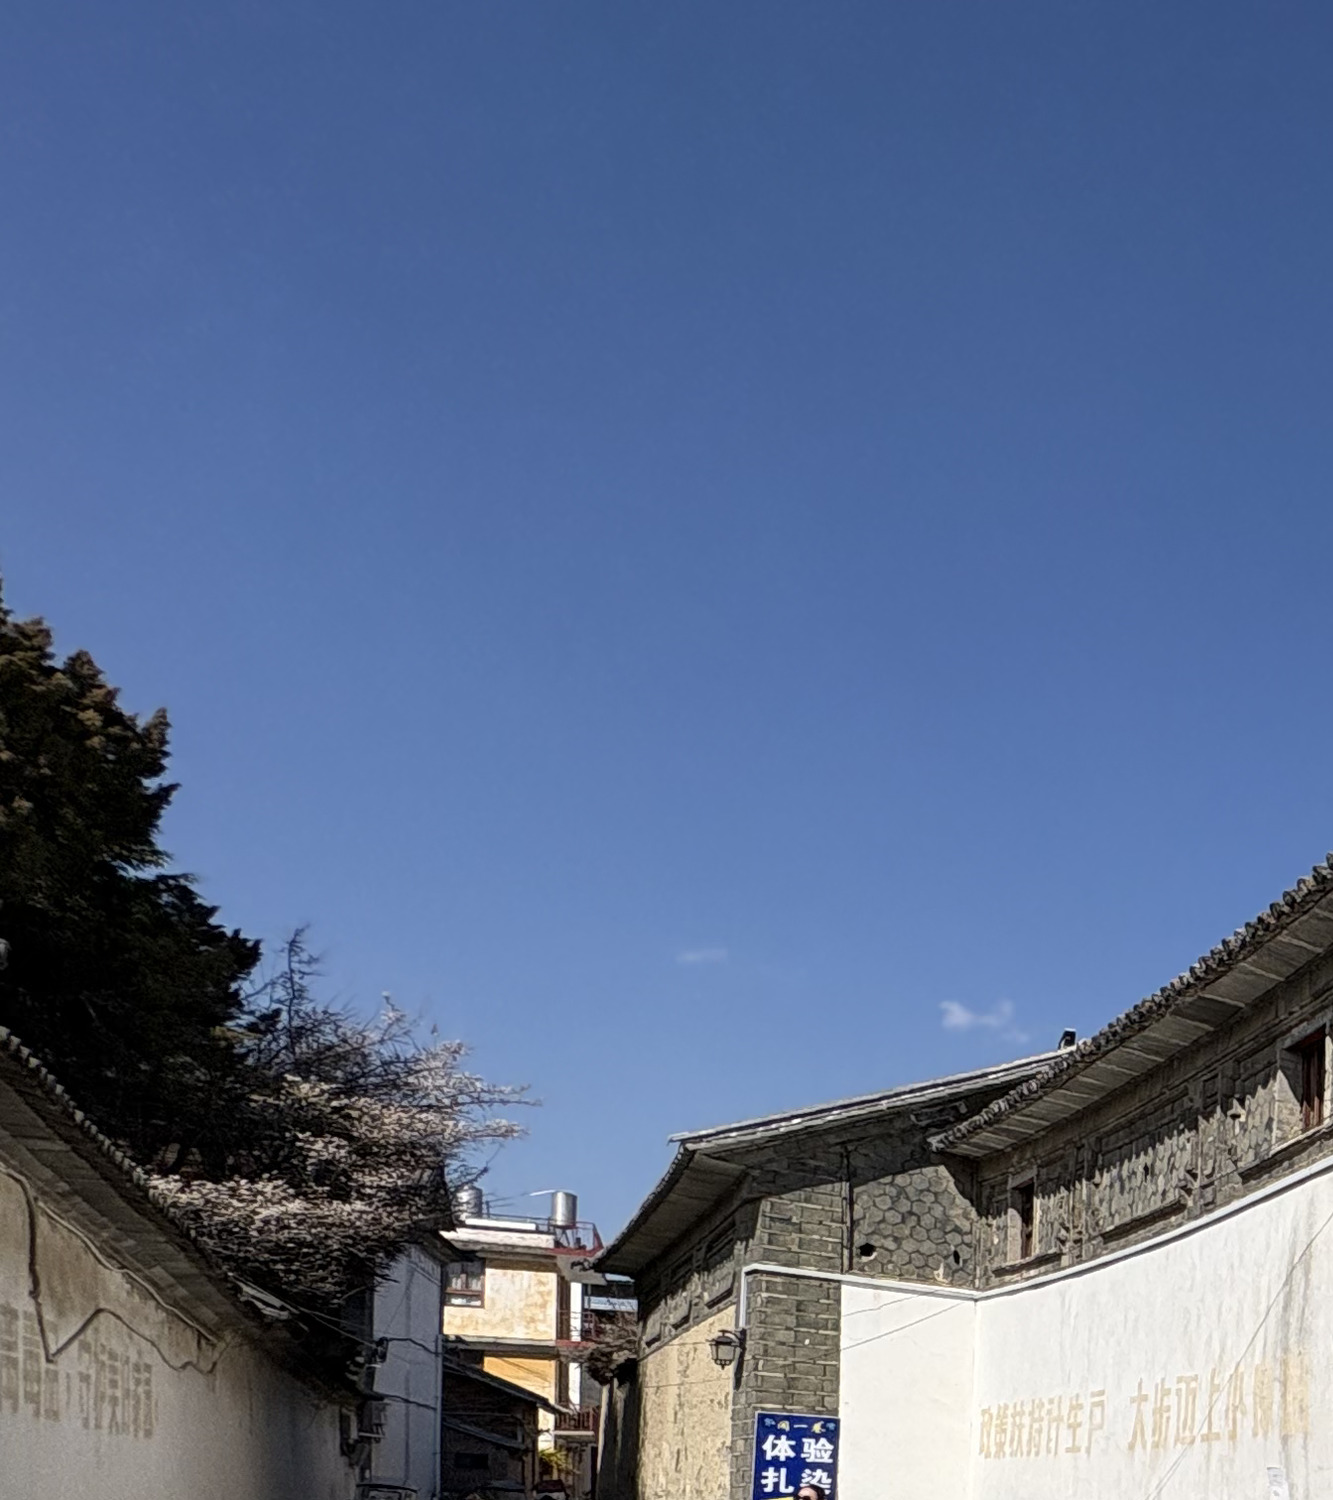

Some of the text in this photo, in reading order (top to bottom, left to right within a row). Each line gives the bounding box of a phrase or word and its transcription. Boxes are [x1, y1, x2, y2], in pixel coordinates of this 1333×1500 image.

[1128, 1351, 1310, 1452] 大步迈上小
[762, 1434, 834, 1463] 体验
